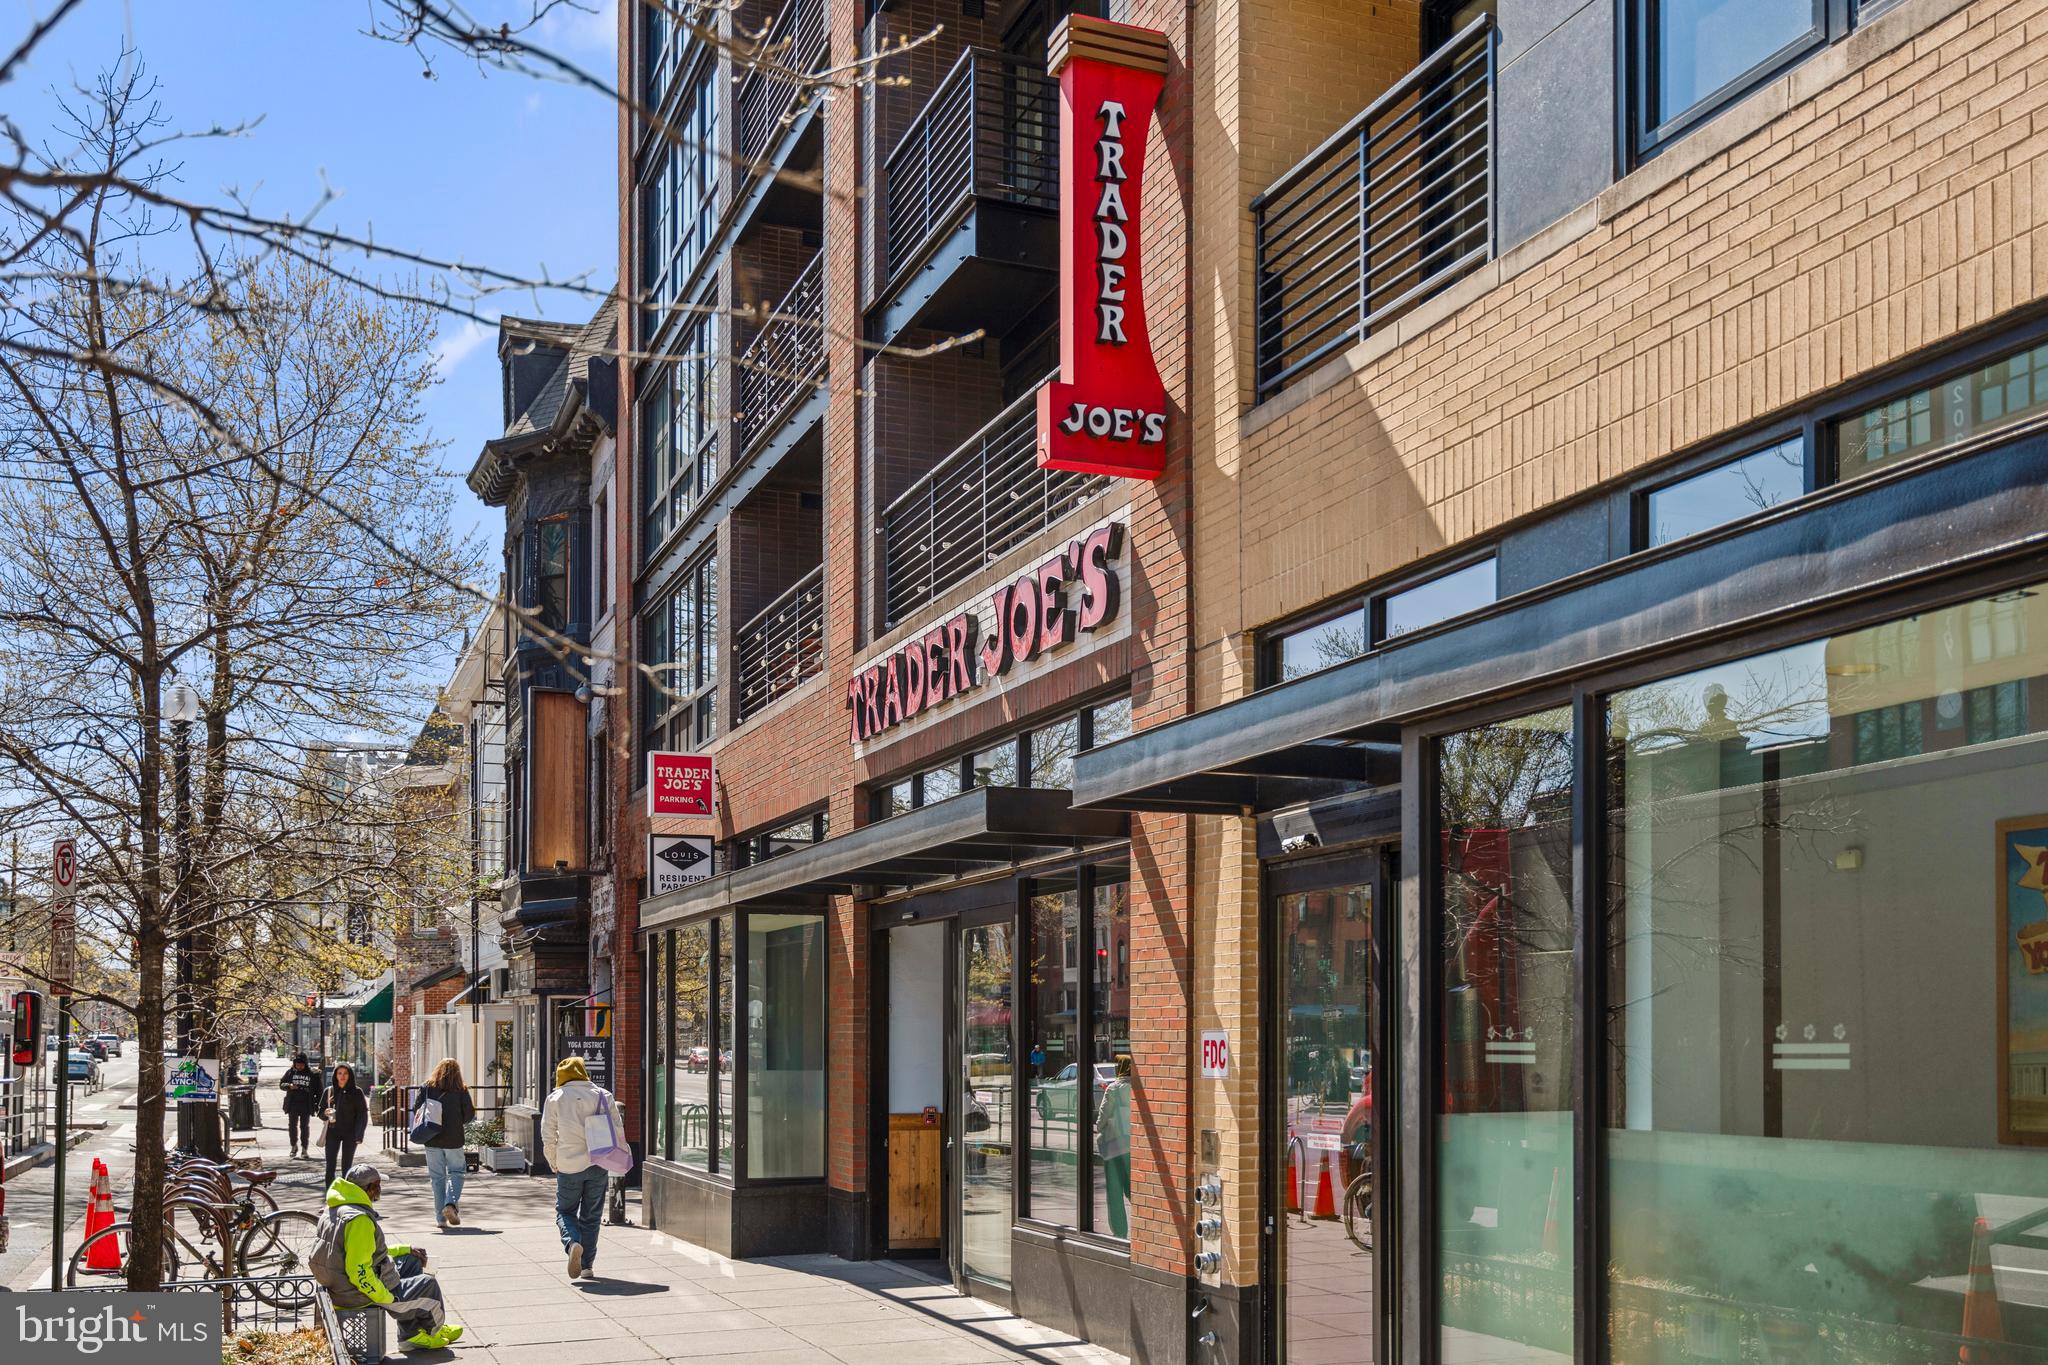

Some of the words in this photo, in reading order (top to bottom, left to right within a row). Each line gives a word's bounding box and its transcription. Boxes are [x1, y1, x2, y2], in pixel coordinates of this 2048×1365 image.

[1097, 100, 1128, 345] TRADER
[1060, 403, 1166, 442] JOE'S
[846, 611, 979, 745] TRADER
[979, 521, 1126, 678] JOE'S
[656, 766, 710, 779] TRADER
[664, 779, 703, 791] JOE'S
[659, 795, 694, 804] PARKING
[664, 852, 699, 860] LOUIS
[659, 874, 707, 883] RESIDENT
[1203, 1039, 1226, 1070] FDC
